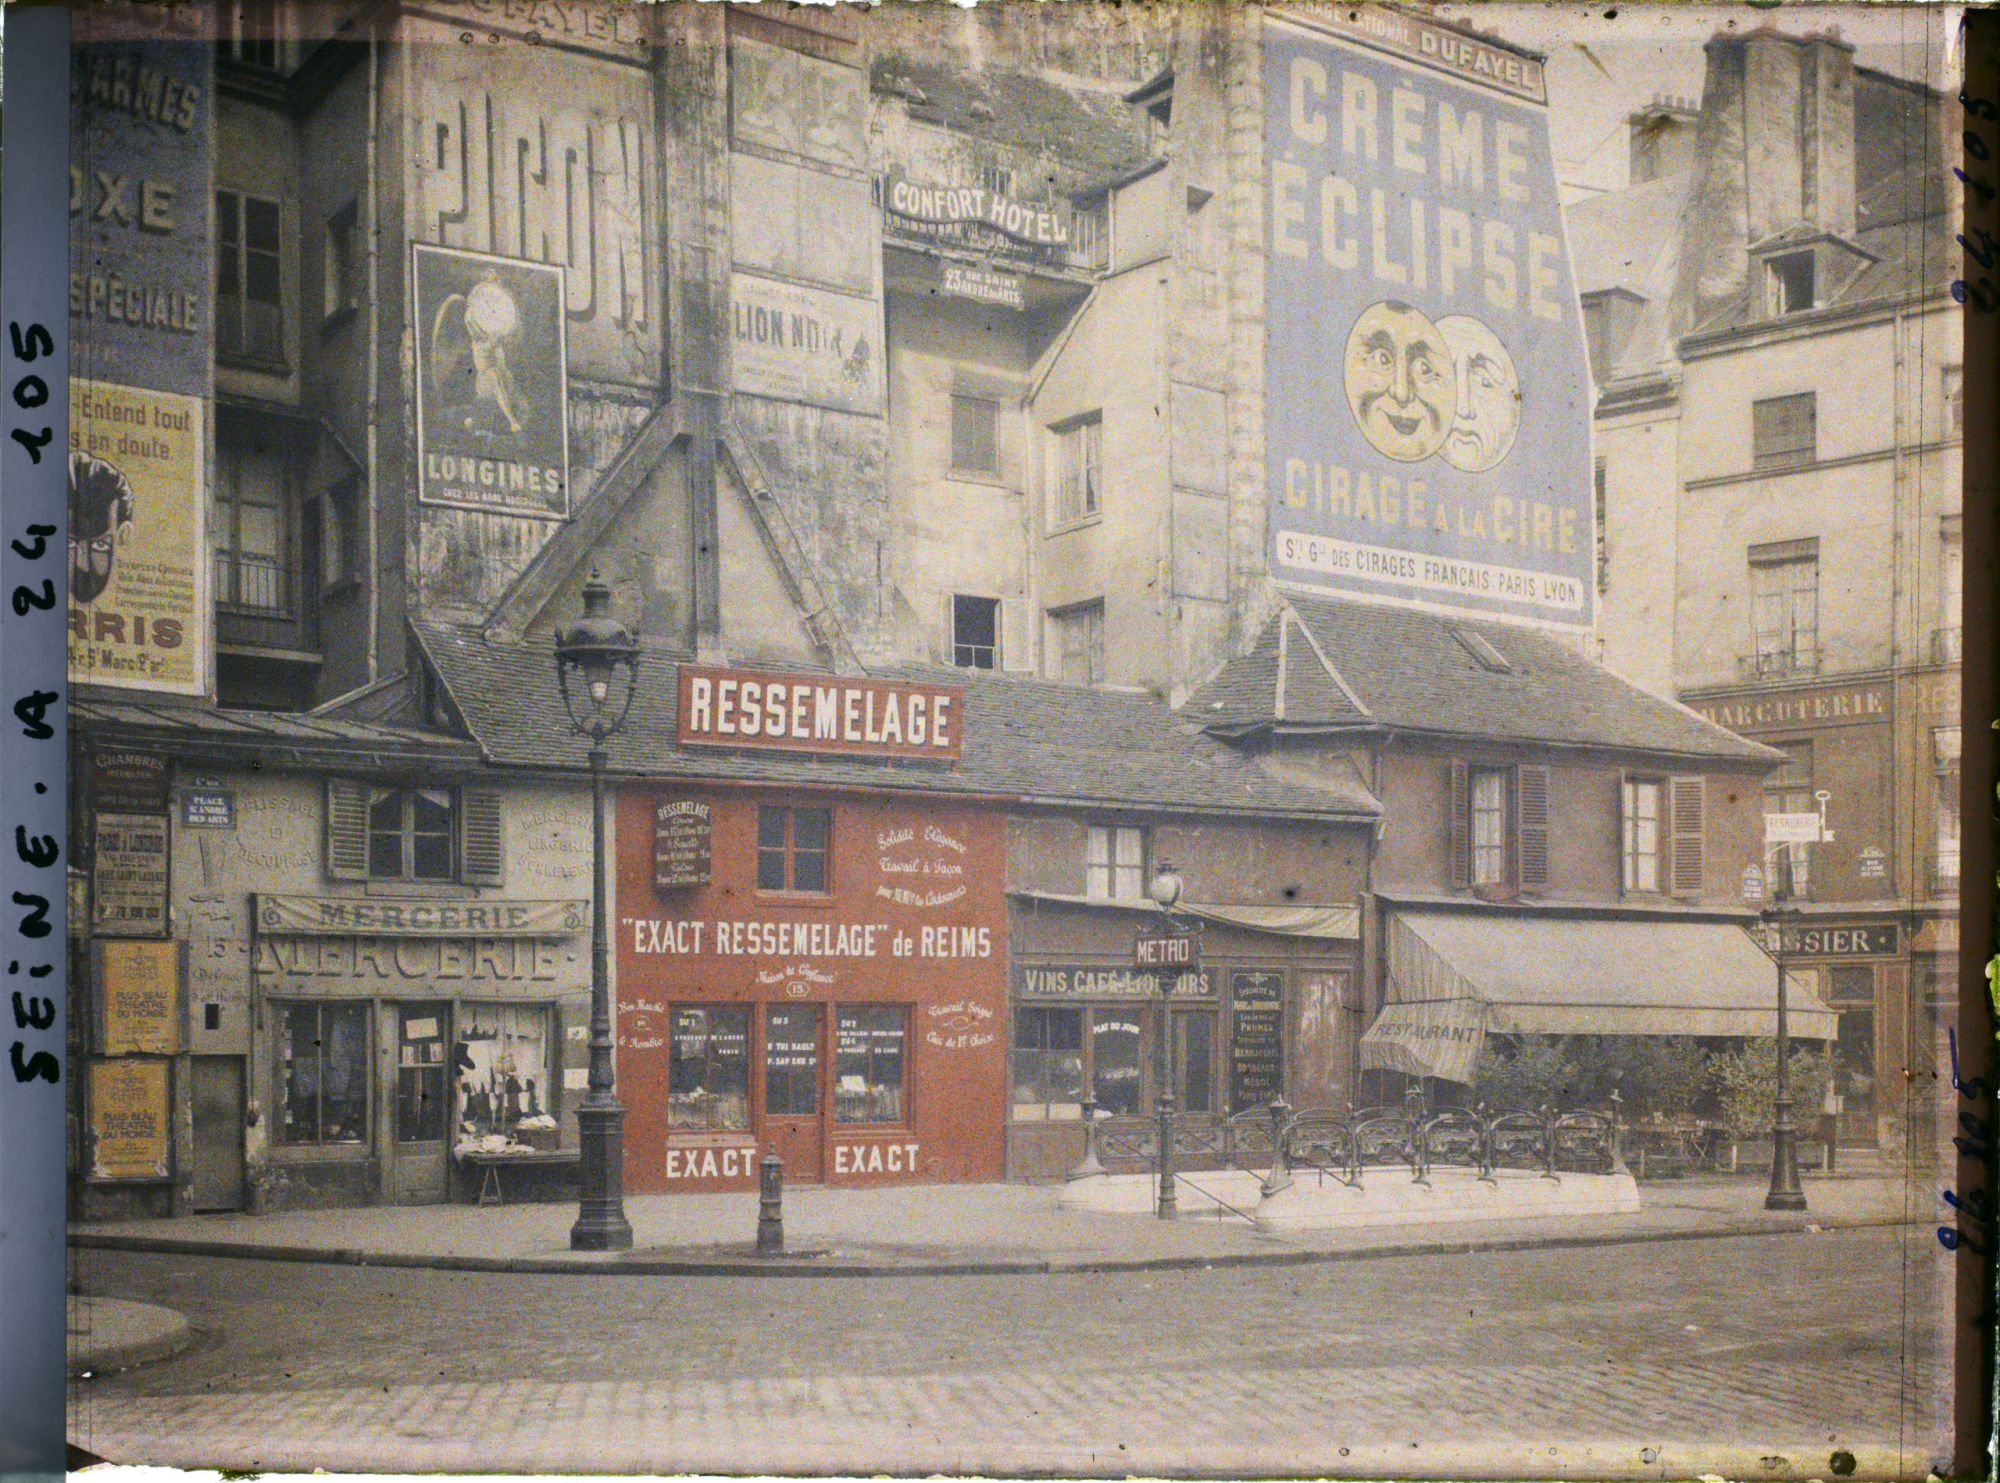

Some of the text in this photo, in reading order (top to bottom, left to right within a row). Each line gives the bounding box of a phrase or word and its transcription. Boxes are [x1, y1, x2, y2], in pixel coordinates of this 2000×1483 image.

[1421, 31, 1536, 90] DUFAYEL
[893, 181, 1067, 242] CONFORT HOTEL
[944, 267, 962, 292] 23
[734, 300, 784, 348] LION
[153, 405, 190, 431] tout
[427, 452, 560, 495] LONGINES
[1285, 456, 1427, 529] CIRAGE
[1457, 506, 1486, 540] LA
[1493, 494, 1578, 554] CIRE
[11, 524, 58, 616] 24
[1356, 549, 1416, 579] CIRAGES
[1498, 572, 1536, 598] PARIS
[1543, 579, 1576, 603] LYON
[690, 676, 951, 747] RESSEMELAGE
[96, 753, 164, 771] CHAMBRES
[657, 800, 710, 821] RESSEMELAGE
[316, 903, 528, 930] MERCERIE
[622, 919, 705, 954] "EXACT
[892, 930, 912, 956] de
[920, 926, 991, 958] REIMS
[792, 984, 804, 994] 15
[666, 1149, 756, 1178] EXACT
[835, 1144, 919, 1173] EXACT
